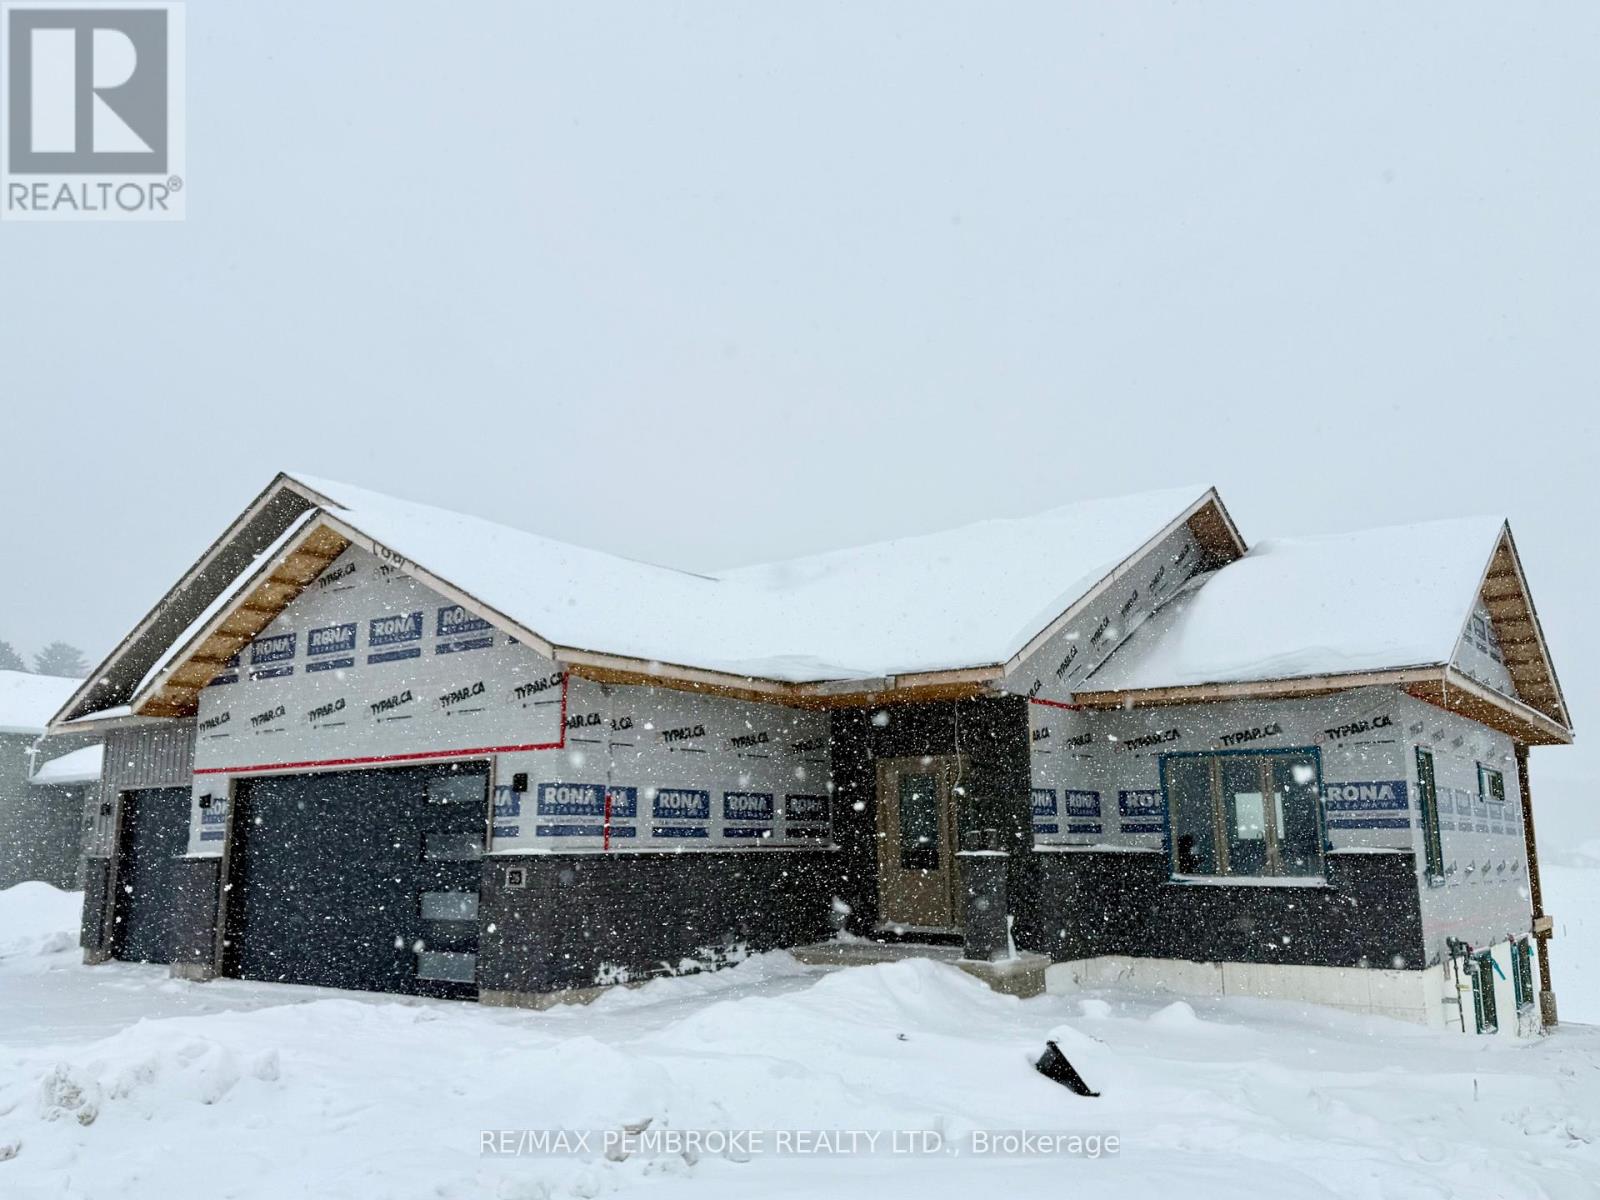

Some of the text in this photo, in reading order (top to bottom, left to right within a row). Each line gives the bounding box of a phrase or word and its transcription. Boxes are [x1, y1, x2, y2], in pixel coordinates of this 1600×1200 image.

[375, 617, 416, 636] RONA
[313, 627, 350, 646] RONA
[255, 639, 290, 655] RONA
[370, 690, 412, 715] TYPAR.CA
[439, 681, 485, 708] TYPAR.CA
[1220, 722, 1283, 746] TYPAR.CA
[1324, 715, 1393, 740] TYPAR.CA
[1124, 729, 1181, 751] TYPAR.CA
[545, 787, 596, 804] RONA
[660, 793, 704, 809] RONA
[1327, 785, 1396, 801] RONA
[729, 796, 768, 811] RONA
